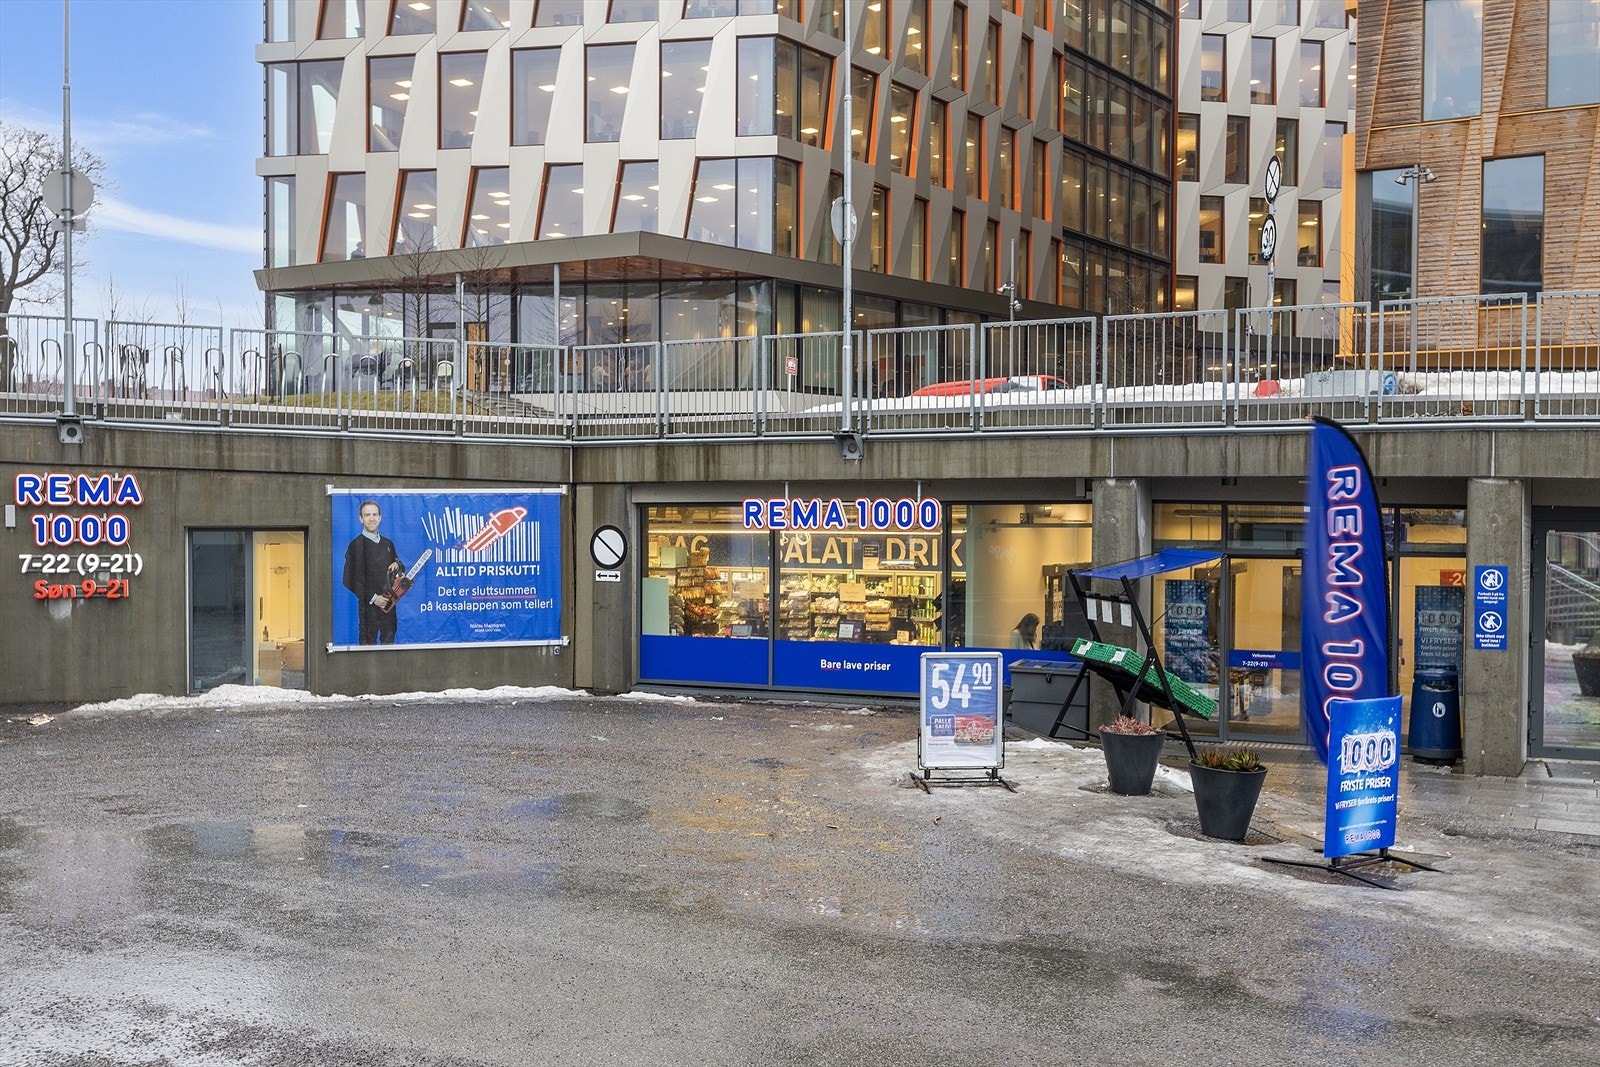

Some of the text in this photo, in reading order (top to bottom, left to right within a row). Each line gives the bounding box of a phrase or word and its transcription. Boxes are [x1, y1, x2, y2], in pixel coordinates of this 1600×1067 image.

[15, 472, 143, 506] REMA
[742, 497, 942, 530] REMA 1000
[31, 513, 130, 547] 1000
[1323, 466, 1364, 624] REMA
[19, 553, 143, 576] 7-22 (9-21)
[435, 564, 540, 577] ALLTID PRISKUTT!
[33, 579, 129, 599] Søn 9-21
[438, 586, 537, 597] Det er sluttsummen
[420, 599, 553, 613] på kassalappen som teller!
[820, 659, 891, 672] Bare lave priser
[931, 662, 992, 709] 54 90
[1341, 735, 1395, 770] 1000
[1340, 776, 1391, 792] FRYSTE PRISER
